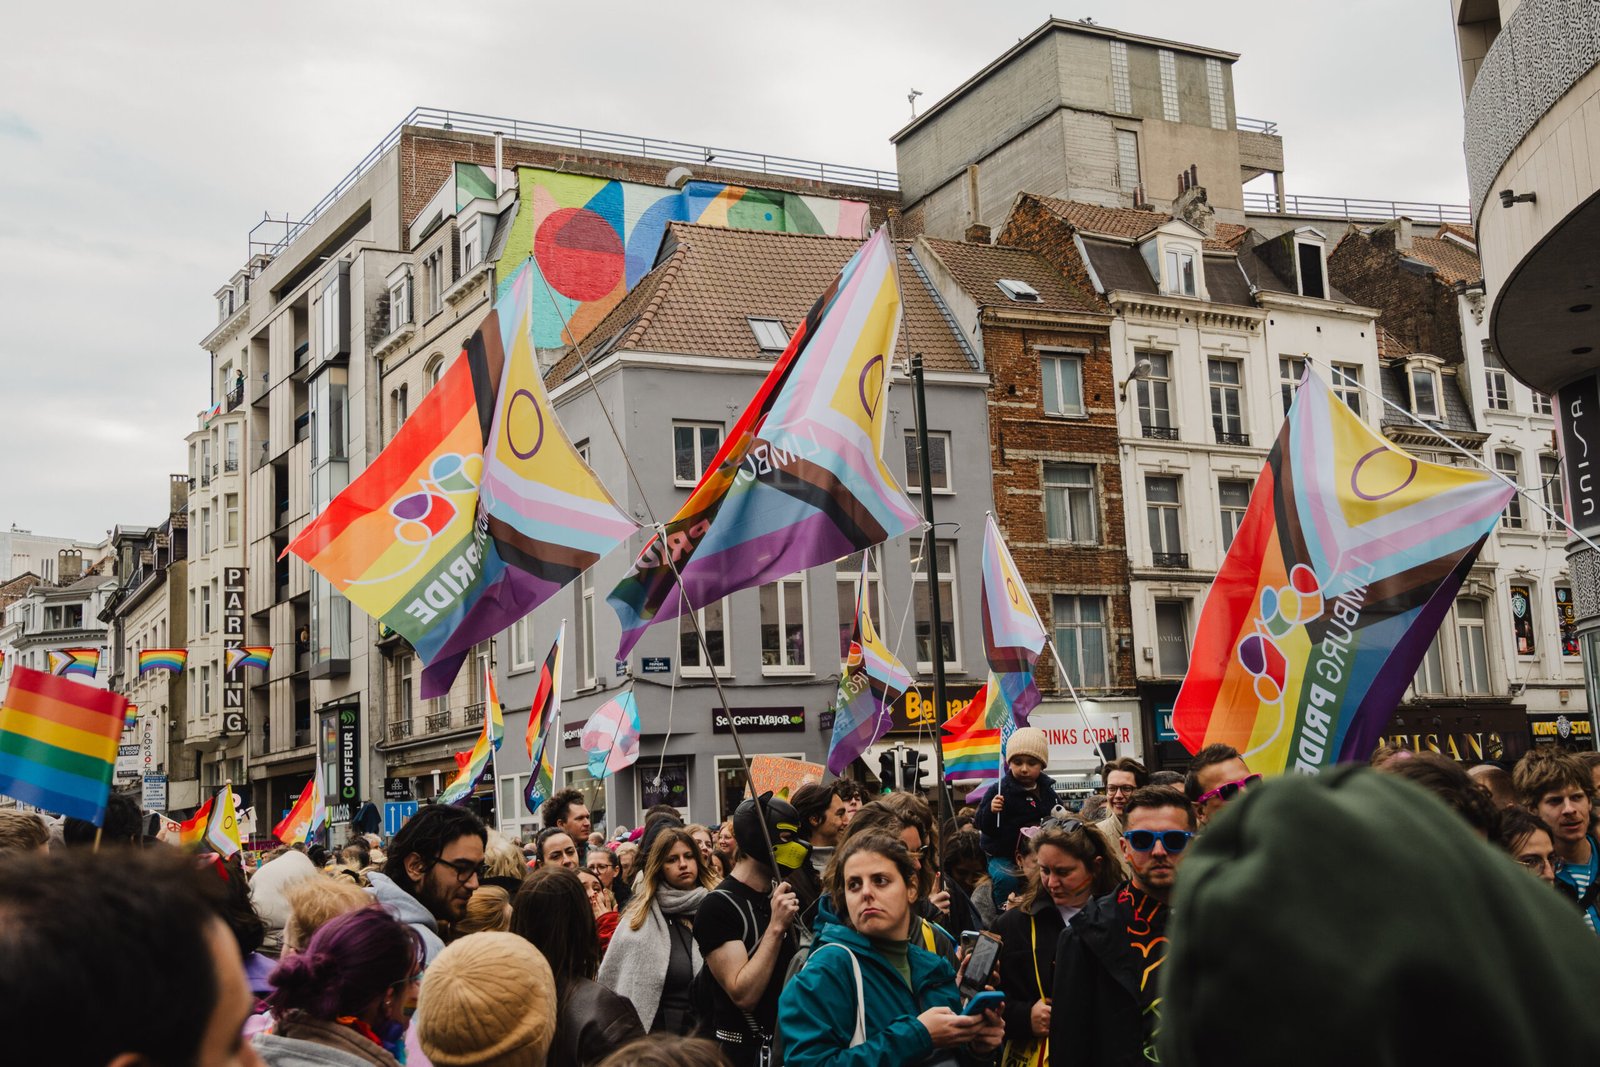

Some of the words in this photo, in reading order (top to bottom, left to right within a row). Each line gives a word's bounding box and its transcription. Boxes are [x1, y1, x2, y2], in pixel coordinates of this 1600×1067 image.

[1532, 721, 1557, 736] KING
[1379, 732, 1484, 762] TISAN
[342, 731, 355, 799] COIFFEUR
